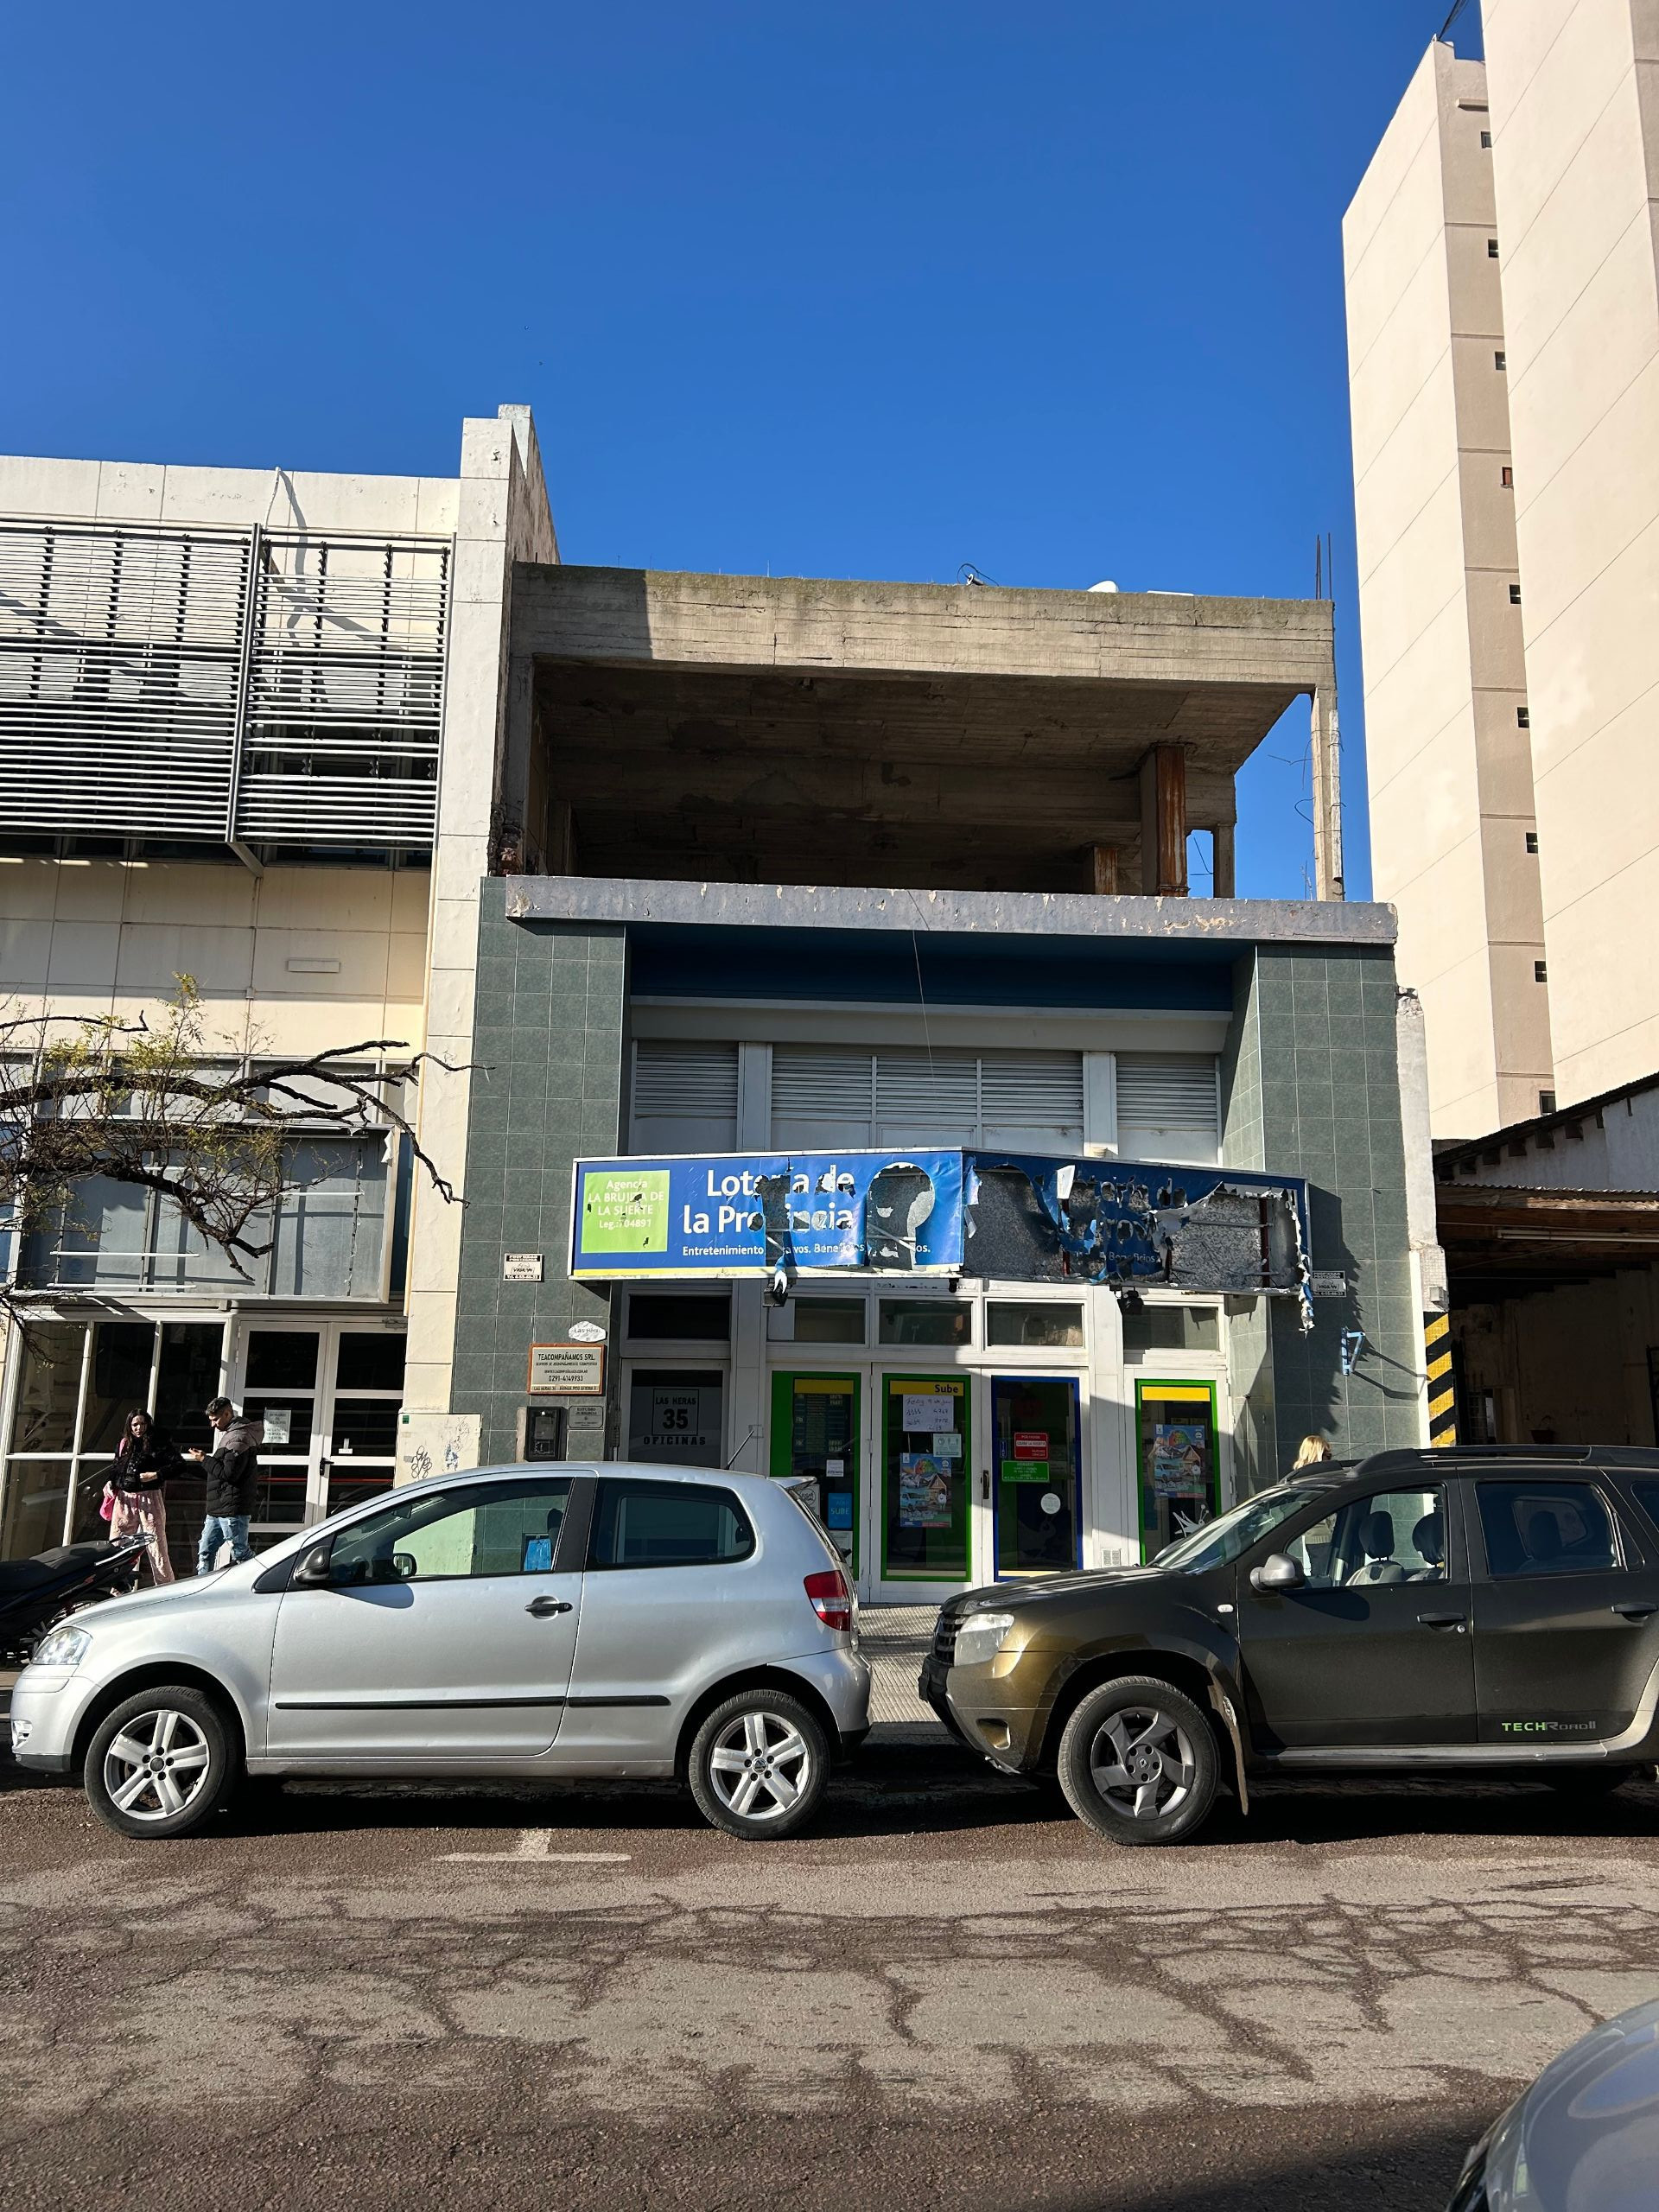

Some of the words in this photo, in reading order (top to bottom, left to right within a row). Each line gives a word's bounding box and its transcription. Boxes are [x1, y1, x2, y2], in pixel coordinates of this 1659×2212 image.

[607, 1179, 648, 1192] Agencia
[588, 1193, 601, 1203] LA
[650, 1192, 664, 1201] DE
[598, 1206, 611, 1216] LA
[613, 1205, 653, 1216] SUERTE
[683, 1205, 709, 1234] la
[683, 1243, 764, 1256] Entretenimiento
[538, 1351, 583, 1361] TEACOMPAÑAMOS
[935, 1384, 958, 1393] Sube
[655, 1396, 669, 1405] LAS
[672, 1396, 696, 1405] HERAS
[663, 1408, 688, 1429] 35
[643, 1436, 706, 1445] OFICINAS
